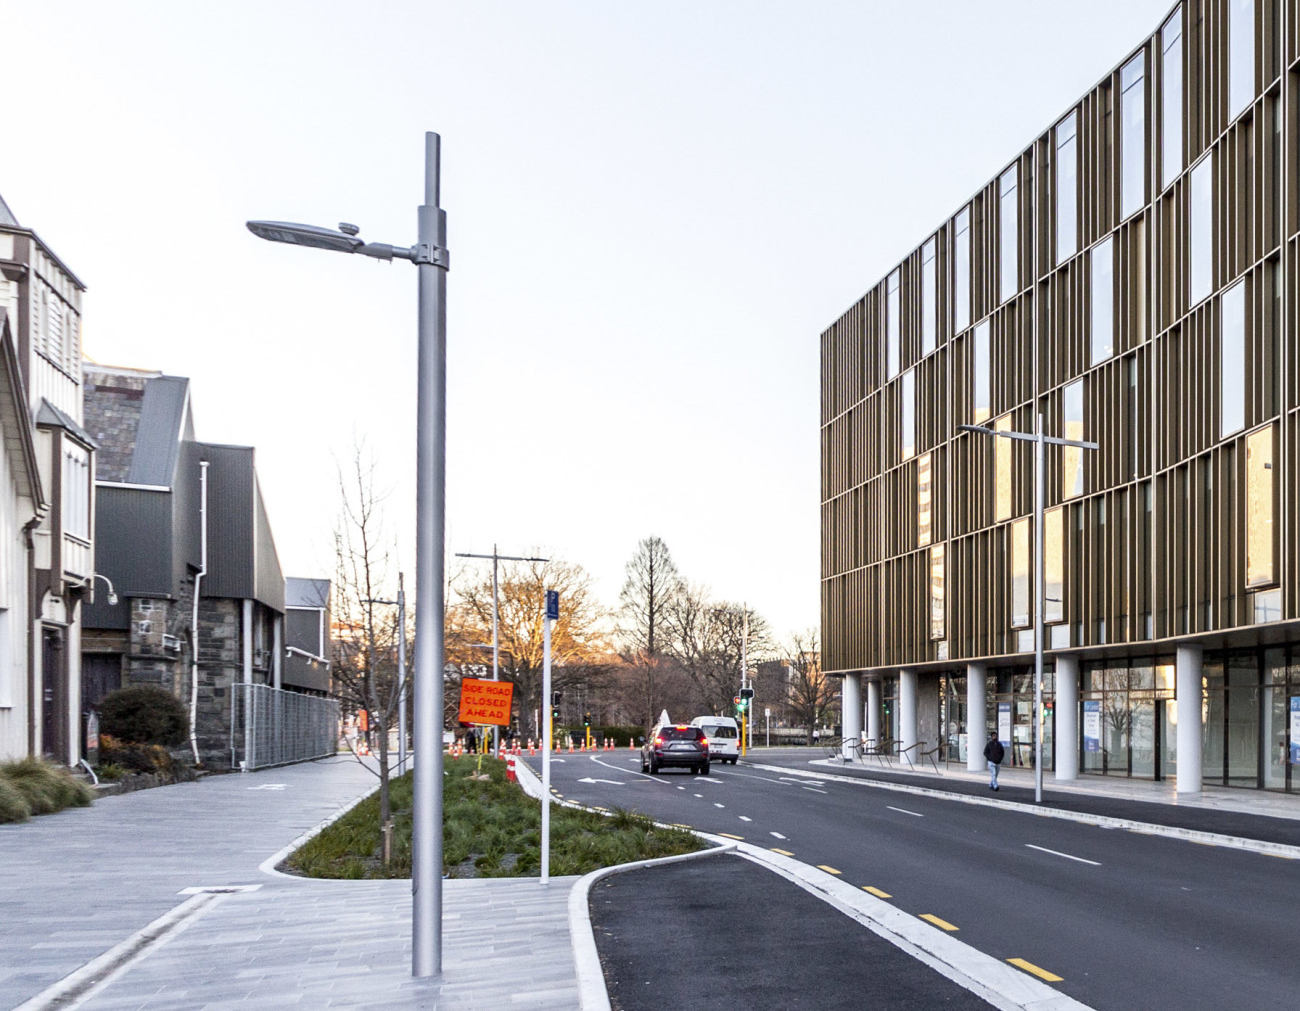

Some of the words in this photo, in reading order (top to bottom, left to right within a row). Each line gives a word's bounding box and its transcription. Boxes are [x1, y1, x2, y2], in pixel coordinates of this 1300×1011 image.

[464, 684, 484, 693] SIDE
[486, 687, 510, 696] ROAD
[465, 697, 507, 707] CLOSED
[466, 709, 503, 718] AHEAD
